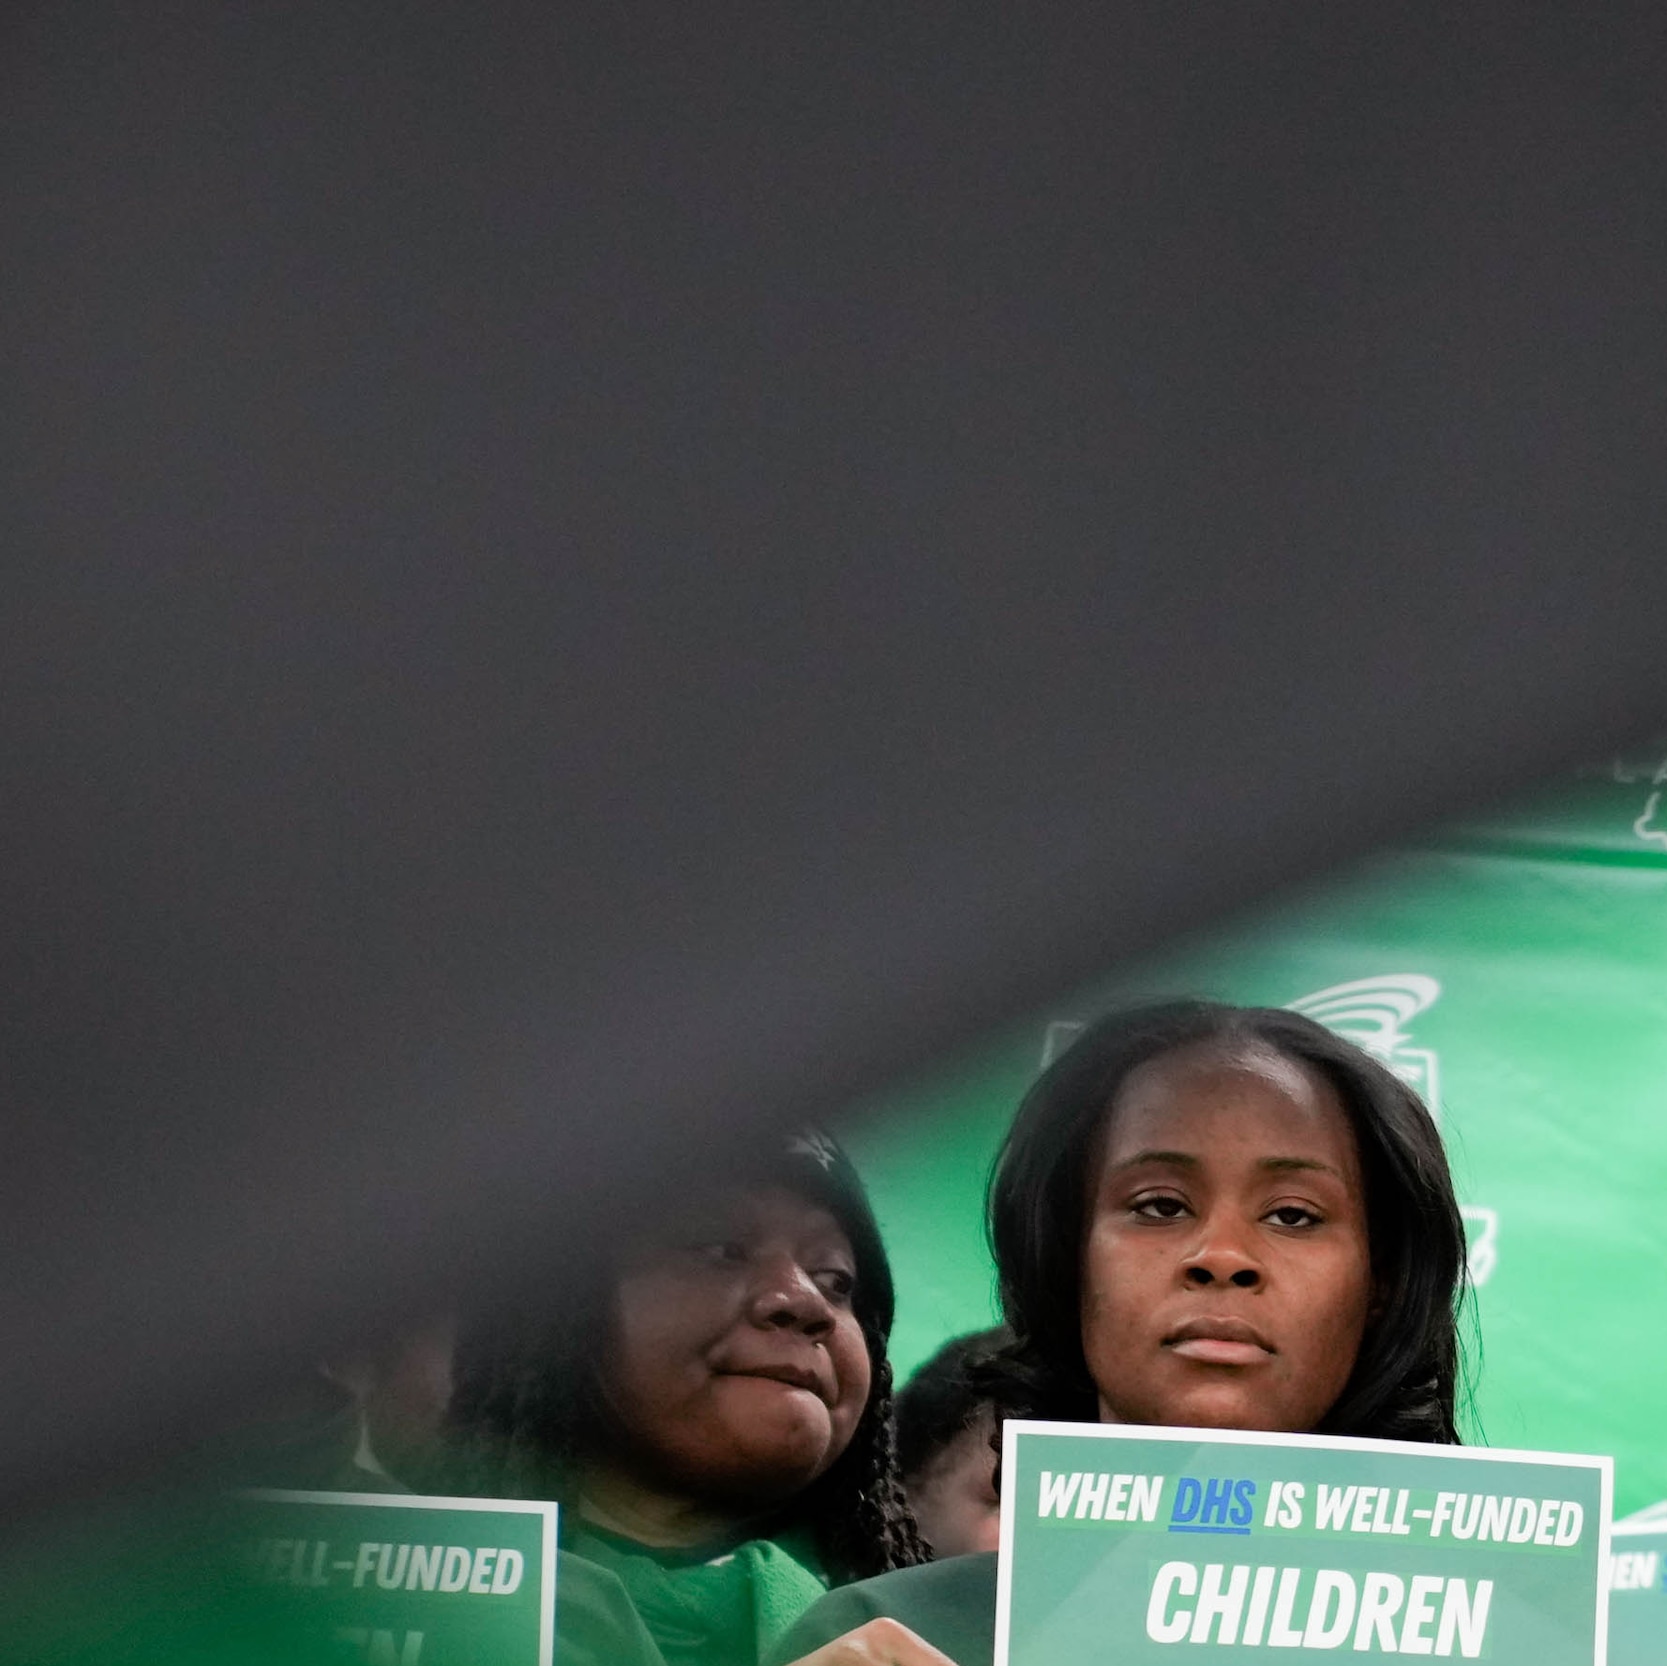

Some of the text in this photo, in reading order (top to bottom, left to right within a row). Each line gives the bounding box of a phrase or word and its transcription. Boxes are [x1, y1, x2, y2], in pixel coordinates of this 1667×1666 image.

[1038, 1471, 1584, 1548] WHEN DHS IS WELL-FUNDED
[1146, 1561, 1494, 1658] CHILDREN
